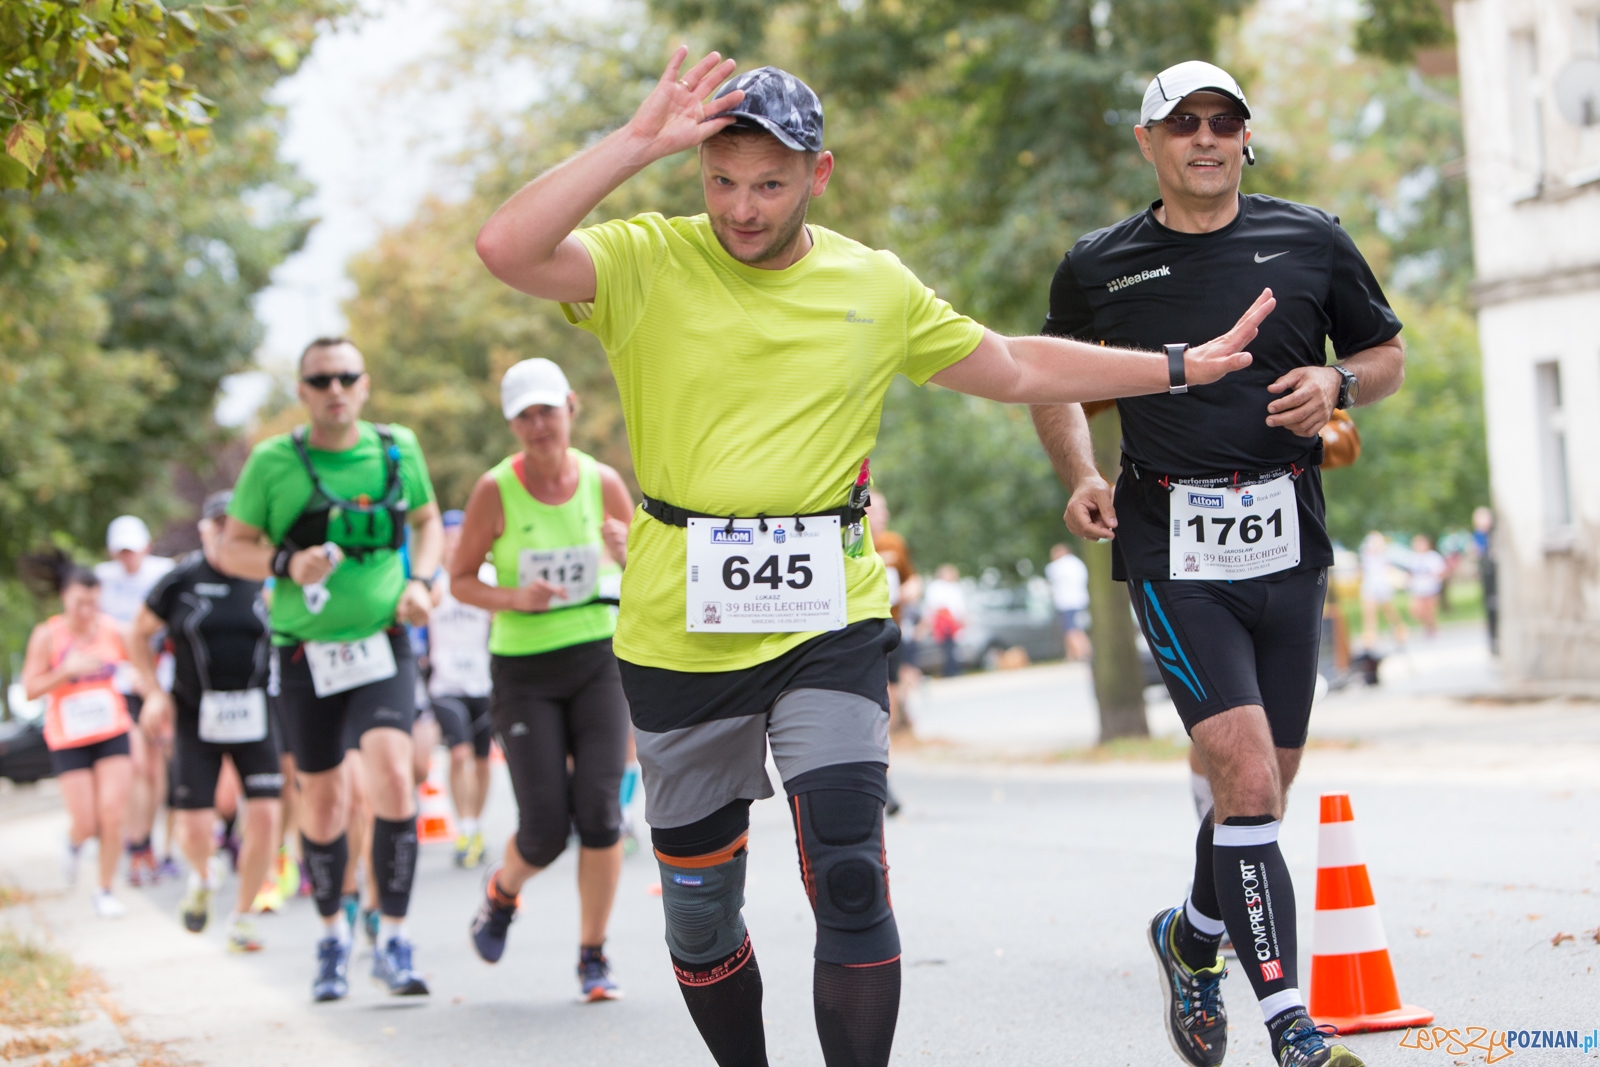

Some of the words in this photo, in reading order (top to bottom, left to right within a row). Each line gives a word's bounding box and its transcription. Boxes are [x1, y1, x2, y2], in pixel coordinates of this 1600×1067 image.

[1178, 476, 1229, 485] performance
[1187, 507, 1282, 546] 1761
[1203, 553, 1215, 562] 39
[1218, 554, 1241, 563] BIEG
[721, 553, 813, 591] 645
[725, 602, 740, 612] 39
[743, 602, 771, 612] BIEG
